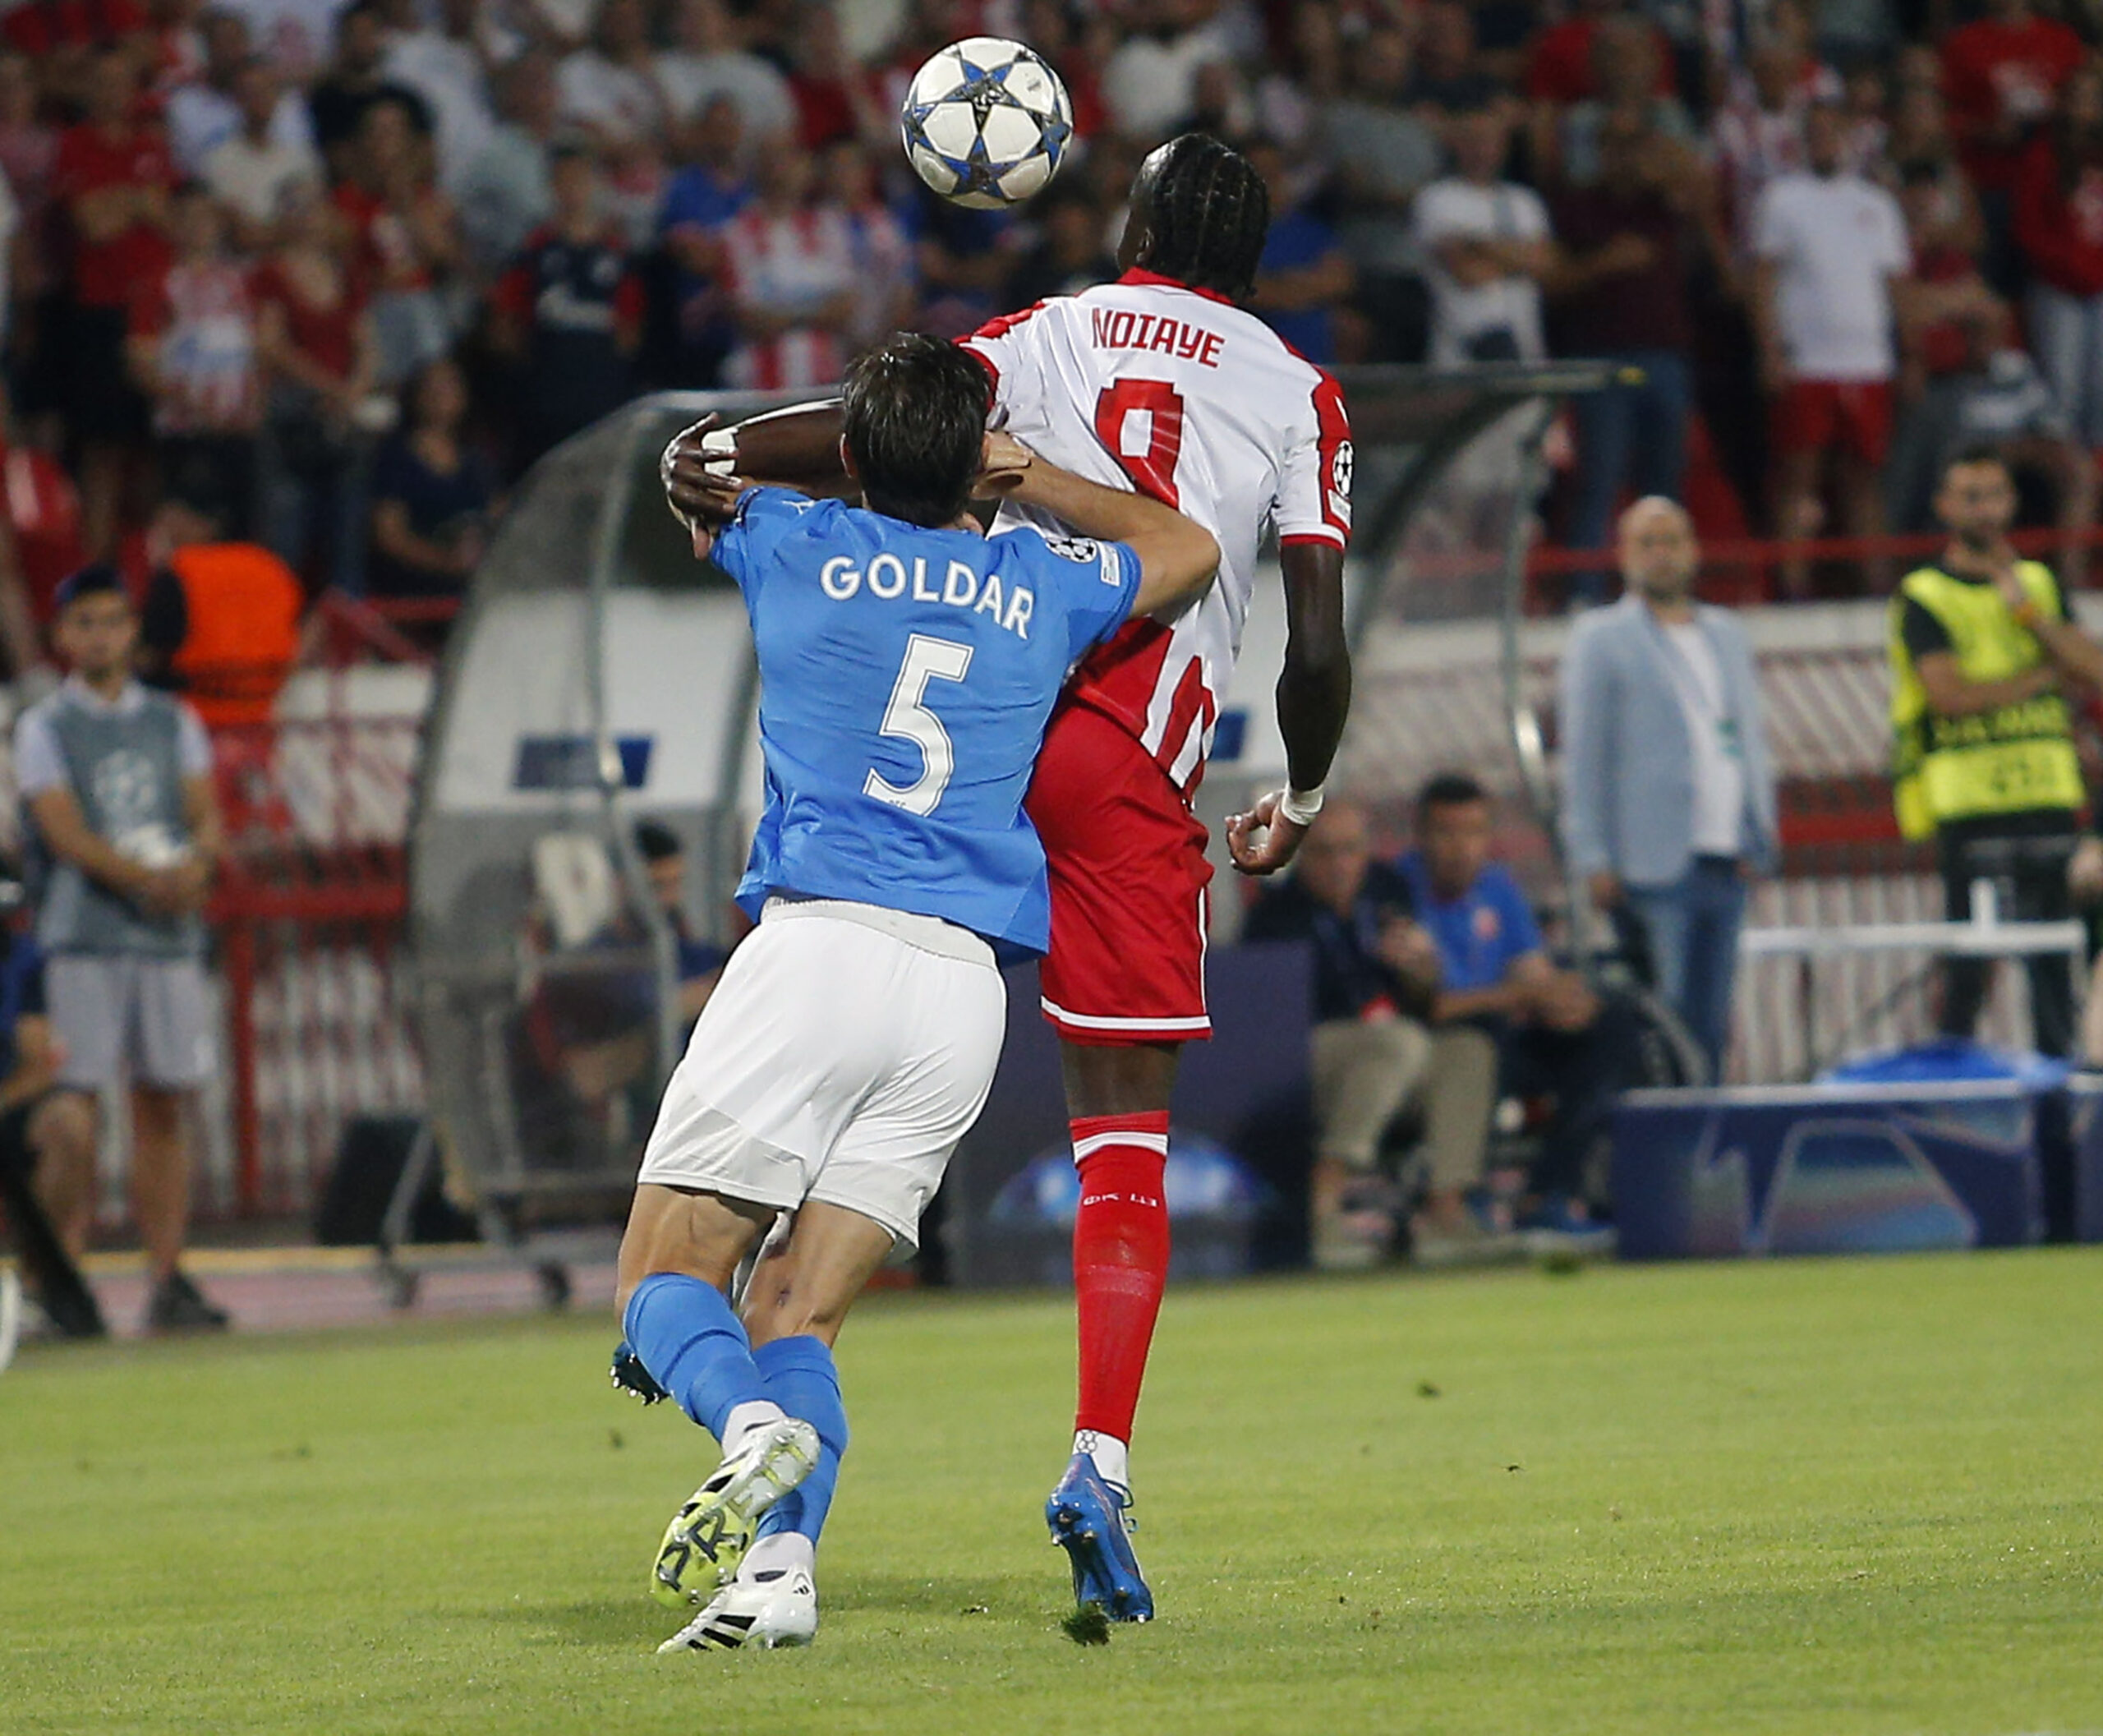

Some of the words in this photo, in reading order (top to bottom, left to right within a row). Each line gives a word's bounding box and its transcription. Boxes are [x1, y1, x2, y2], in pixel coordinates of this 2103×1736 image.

[1092, 307, 1225, 368] NDIAYE
[820, 553, 1033, 639] GOLDAR
[863, 633, 974, 817] 5
